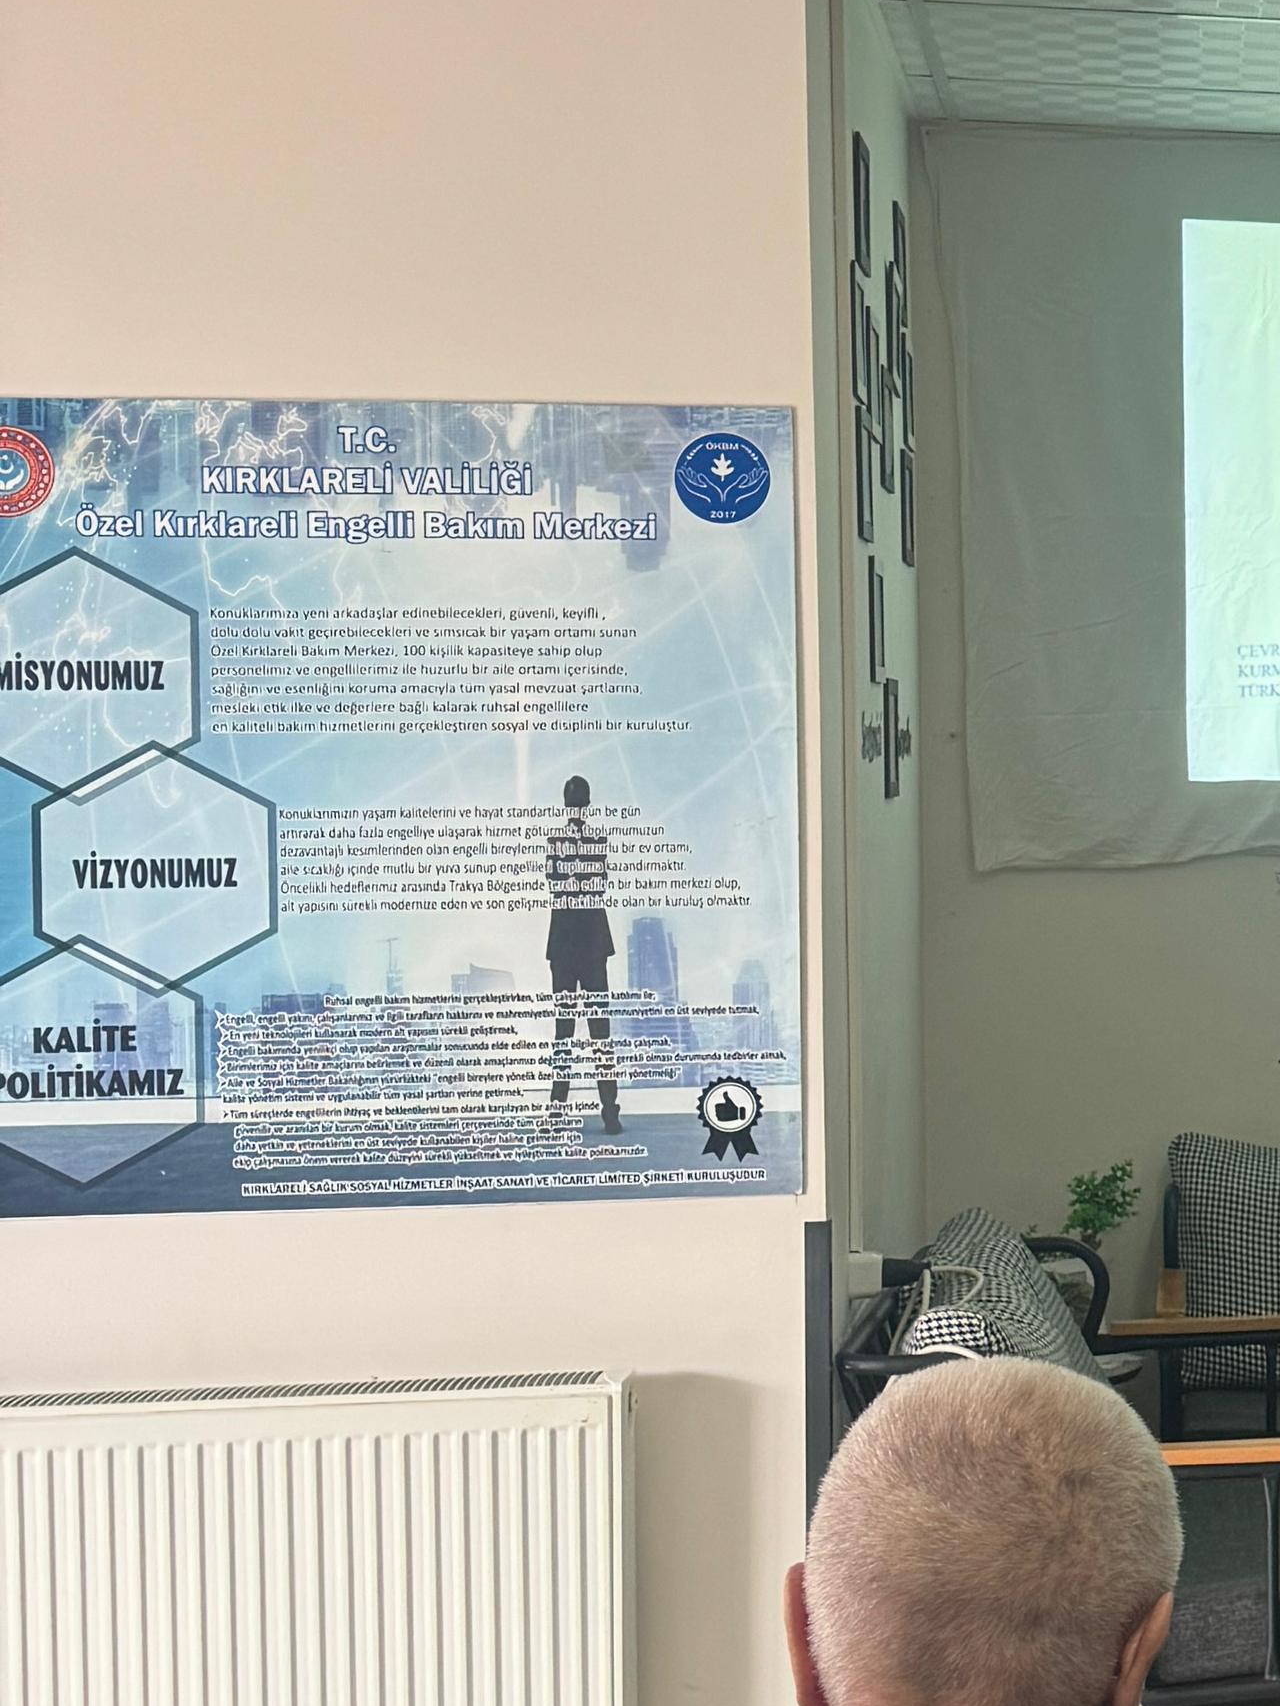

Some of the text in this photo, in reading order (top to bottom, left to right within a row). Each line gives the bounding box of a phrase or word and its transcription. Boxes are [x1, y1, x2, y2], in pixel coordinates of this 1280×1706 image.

[337, 425, 397, 453] T.C.
[201, 460, 533, 496] KIRKLARELİ VALİLİĞİ
[76, 503, 657, 545] Özel Kırklareli Engelli Bakım Merkezi
[710, 511, 736, 519] 2017
[404, 645, 425, 656] 100
[72, 850, 238, 889] VİZYONUMUZ
[33, 1020, 137, 1053] KALİTE
